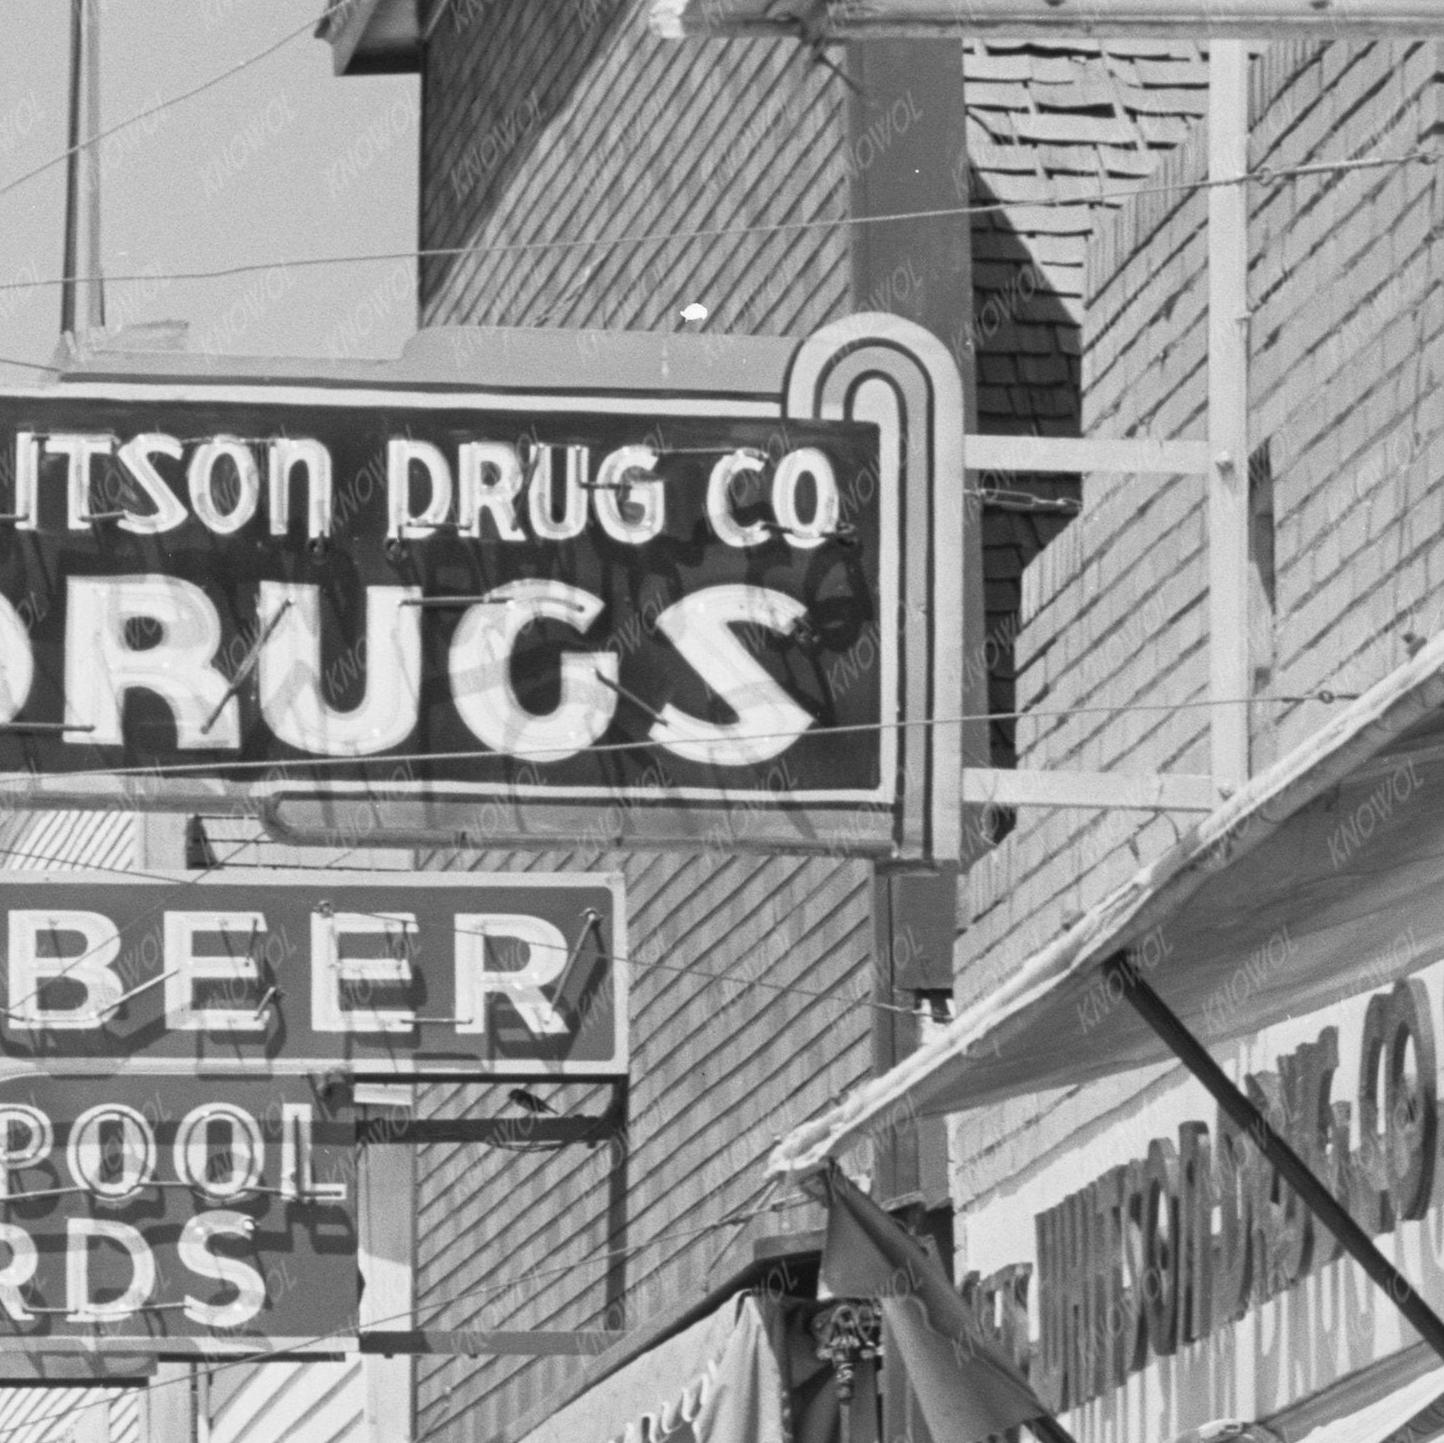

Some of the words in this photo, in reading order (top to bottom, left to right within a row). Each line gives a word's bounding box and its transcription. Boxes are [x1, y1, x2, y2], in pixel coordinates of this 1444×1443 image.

[389, 439, 666, 547] DRUG
[706, 446, 845, 550] CO
[5, 909, 570, 1036] BEER
